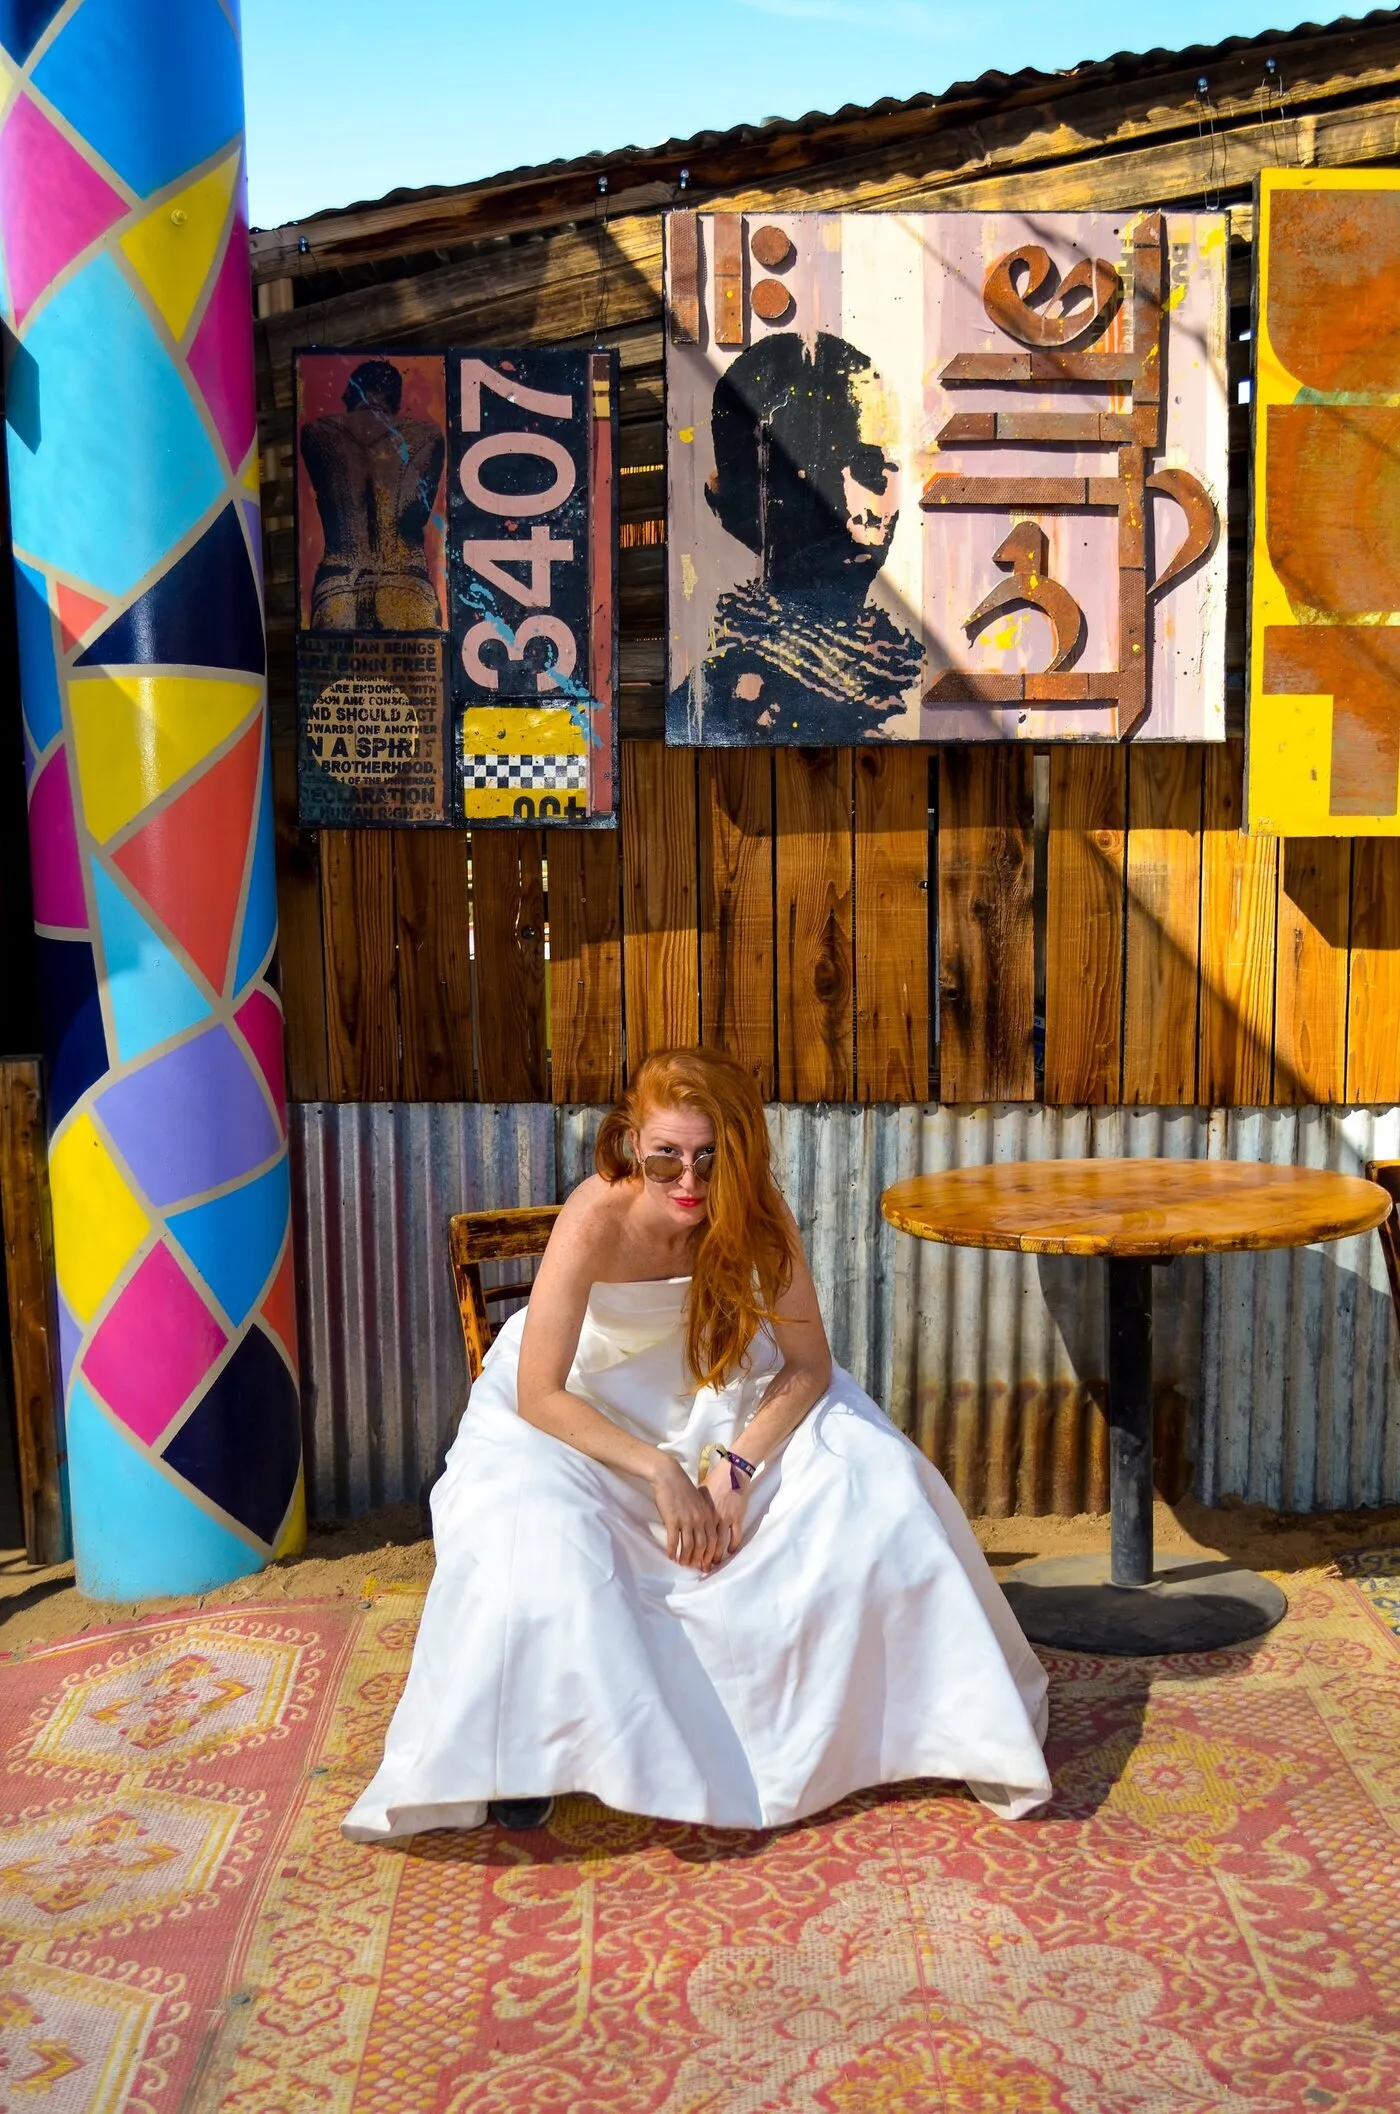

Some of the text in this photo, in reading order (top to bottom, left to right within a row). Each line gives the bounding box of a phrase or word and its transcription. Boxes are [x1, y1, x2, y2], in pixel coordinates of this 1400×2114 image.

[459, 357, 577, 692] 3407
[384, 643, 436, 654] BEINGS
[392, 657, 437, 672] FREE
[335, 707, 401, 722] SHOULD
[405, 708, 437, 722] ACT
[357, 725, 381, 735] ONE
[384, 725, 437, 735] ANOTHER
[331, 737, 349, 758] A
[321, 760, 437, 774] BROTHERHOOD.
[348, 776, 361, 785] OF
[363, 776, 382, 785] THE
